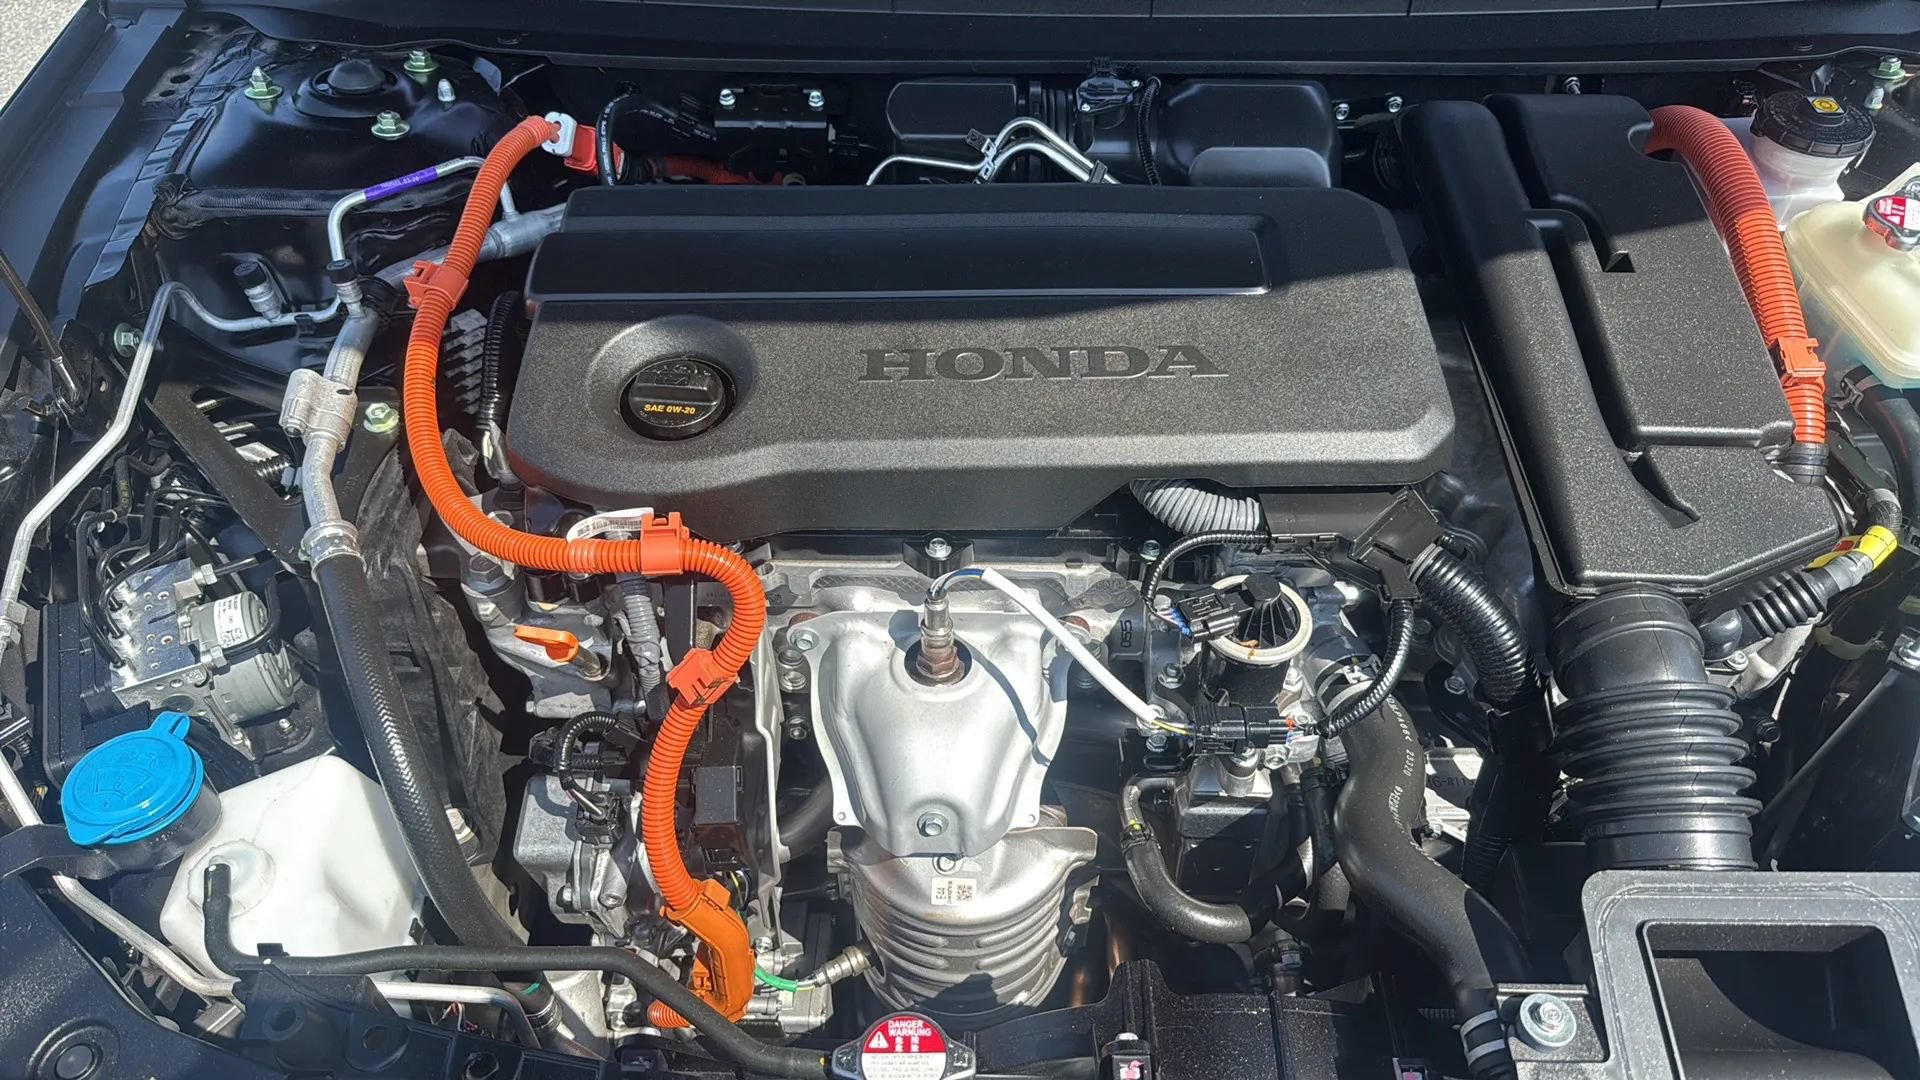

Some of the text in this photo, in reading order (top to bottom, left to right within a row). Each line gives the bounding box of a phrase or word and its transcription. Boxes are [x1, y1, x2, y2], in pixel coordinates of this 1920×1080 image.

[858, 345, 1229, 382] HONDA
[643, 404, 696, 415] SAE 0W-20
[888, 1020, 923, 1028] DANGER
[888, 1028, 931, 1037] WARNUNG
